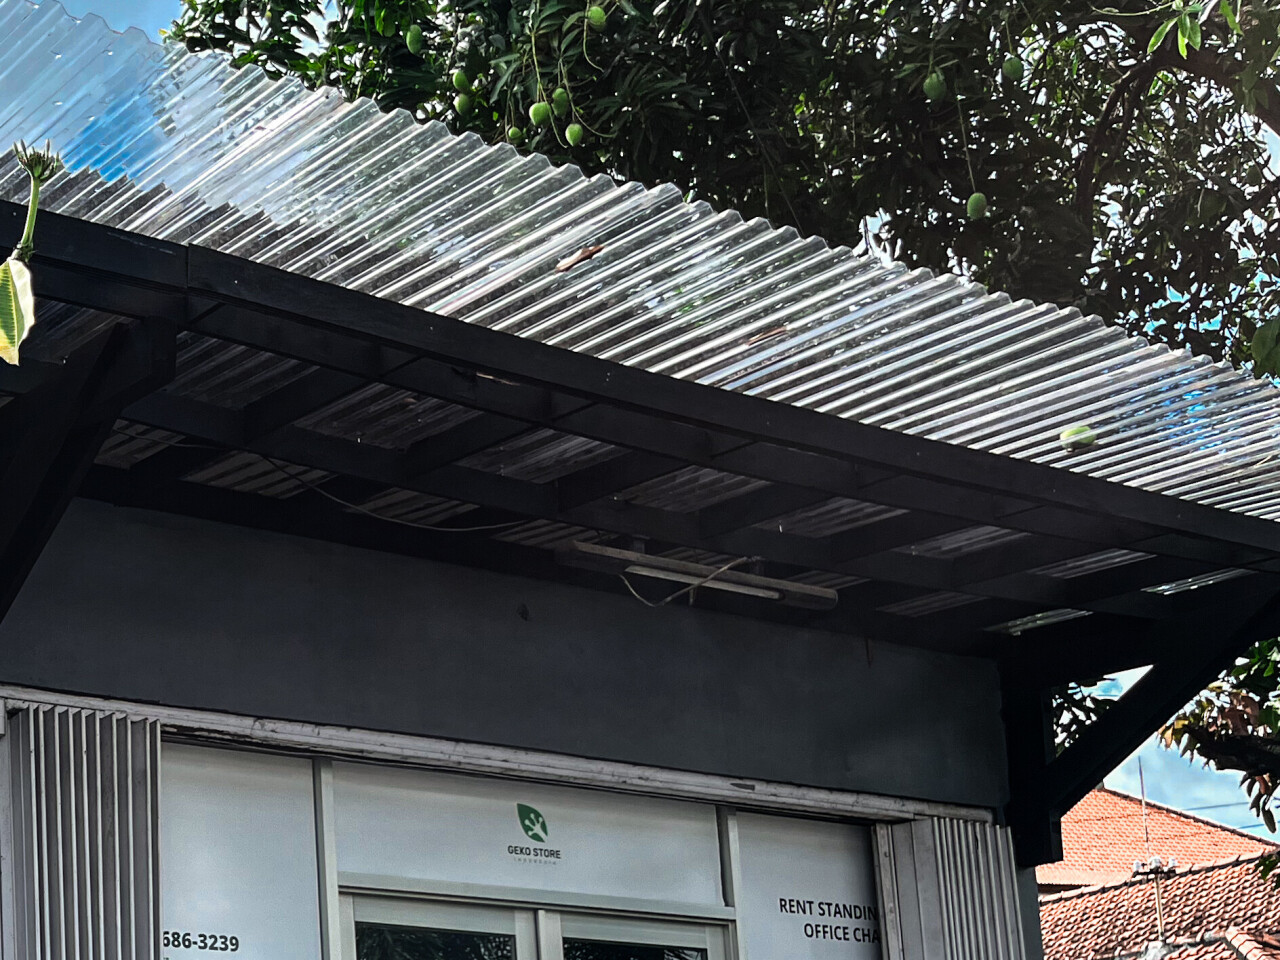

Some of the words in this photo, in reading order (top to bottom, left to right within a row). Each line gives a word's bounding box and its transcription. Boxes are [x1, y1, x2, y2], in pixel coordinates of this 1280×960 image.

[507, 845, 531, 856] GEKO
[532, 848, 561, 859] STORE
[779, 898, 814, 915] RENT
[804, 923, 850, 941] OFFICE
[163, 930, 240, 952] 686-3239
